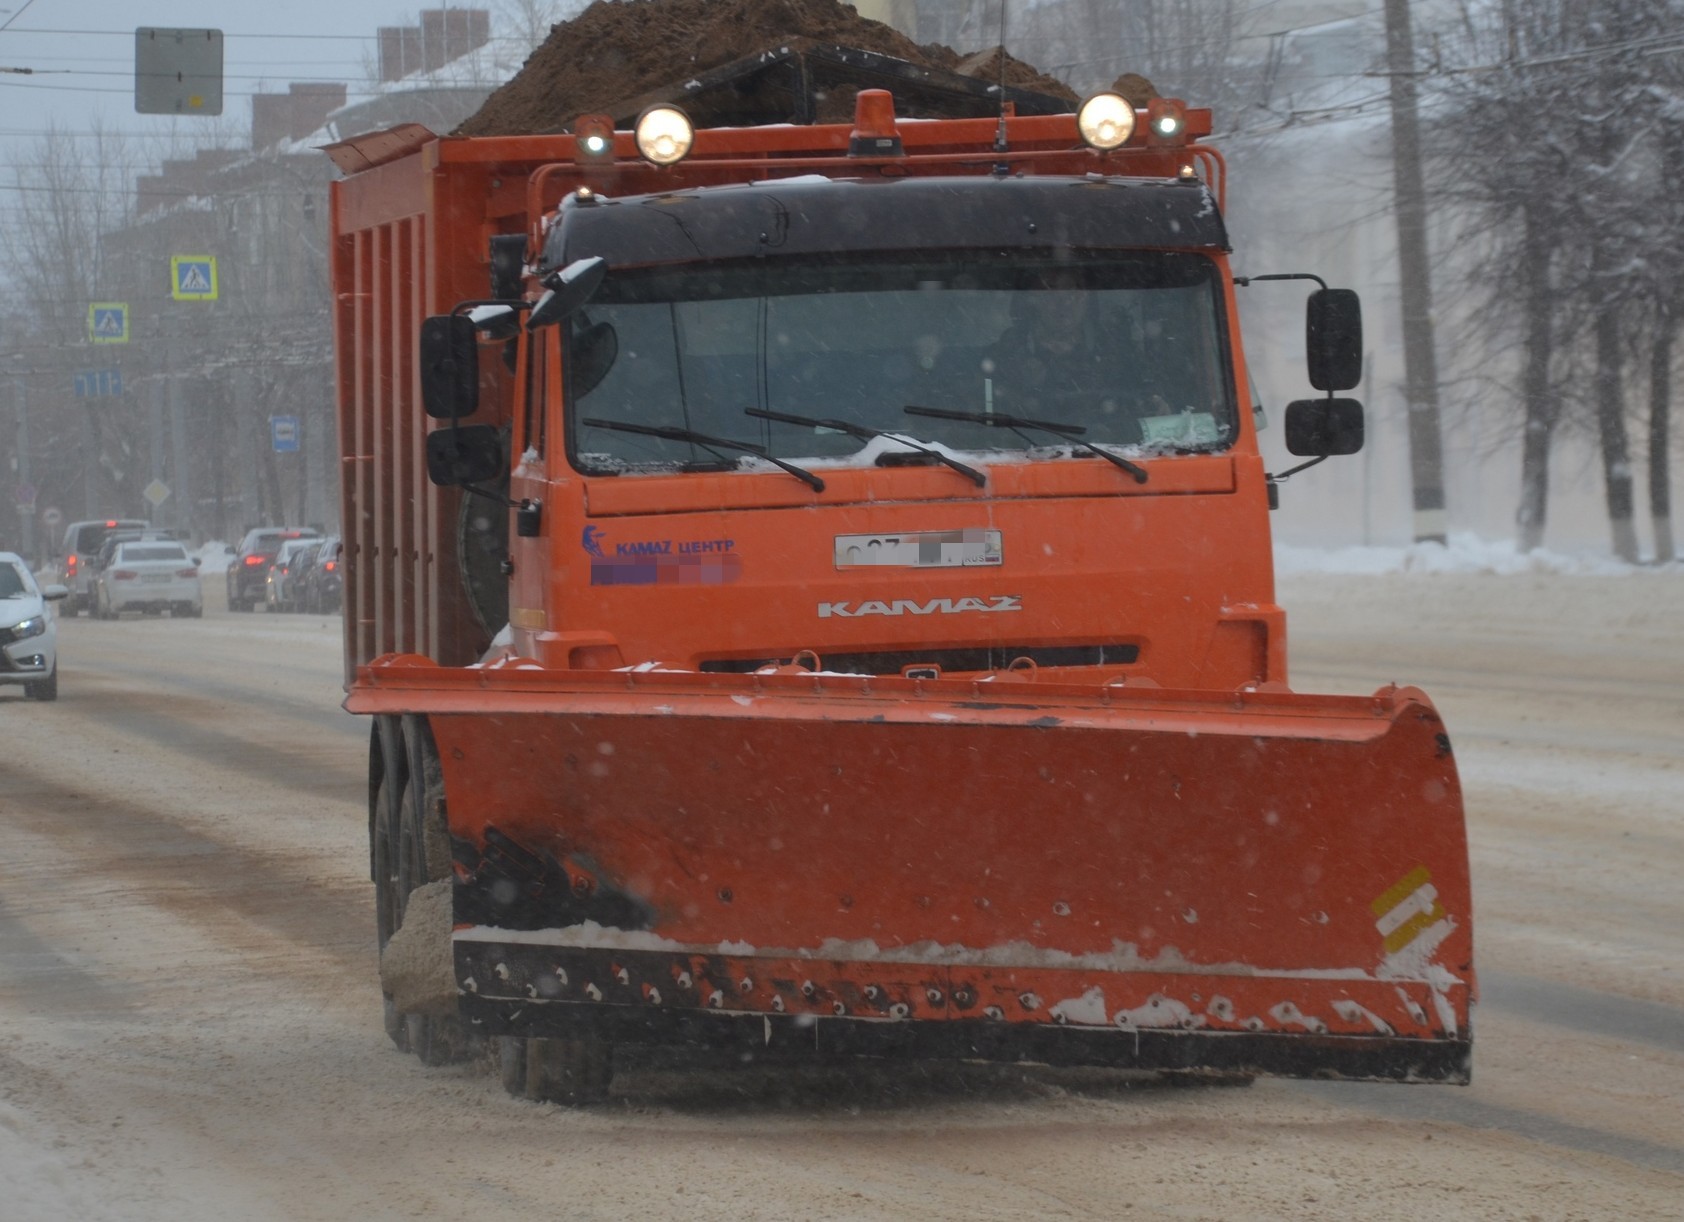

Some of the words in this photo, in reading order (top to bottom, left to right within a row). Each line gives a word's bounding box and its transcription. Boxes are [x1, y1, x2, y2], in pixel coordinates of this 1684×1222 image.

[616, 540, 672, 555] KAMAZ
[678, 540, 735, 554] ЦЕНТР
[817, 595, 1023, 618] KAMAZ
